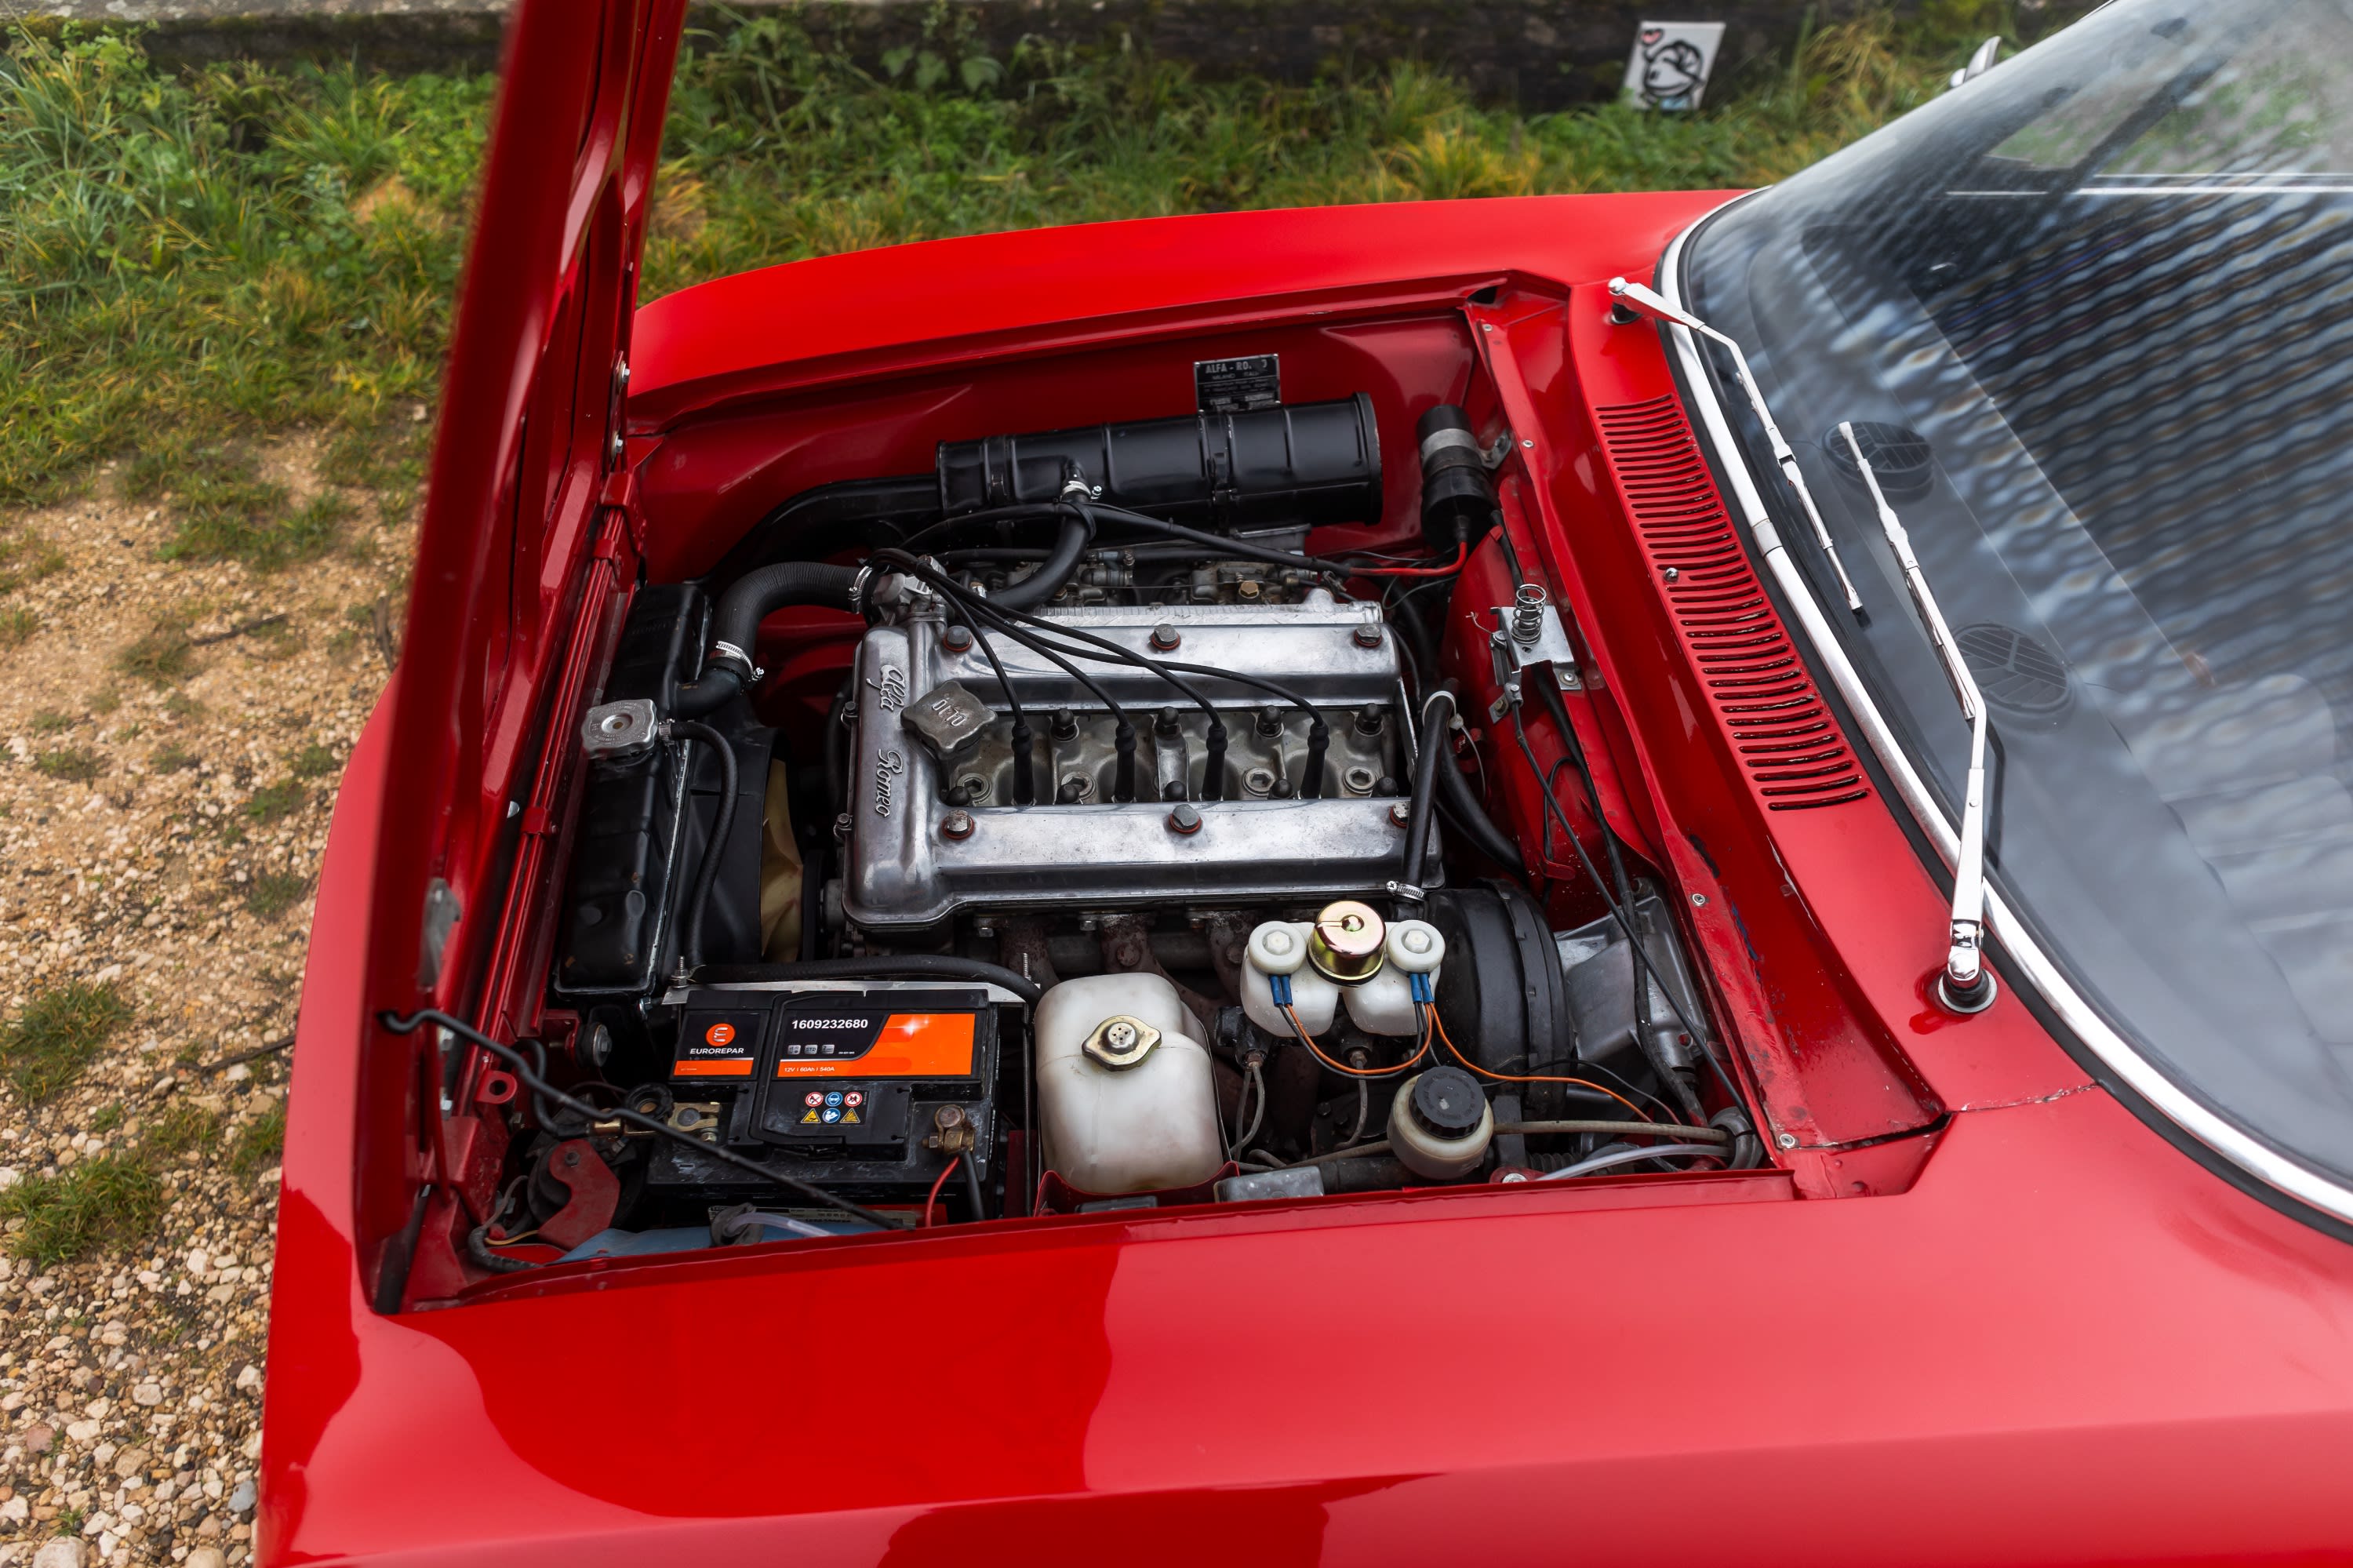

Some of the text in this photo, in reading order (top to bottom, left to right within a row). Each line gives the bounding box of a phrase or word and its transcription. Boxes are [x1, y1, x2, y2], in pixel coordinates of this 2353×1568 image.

[1206, 363, 1227, 374] ALFA
[866, 664, 905, 818] Alfa Romeo
[791, 1019, 868, 1029] 1609232680
